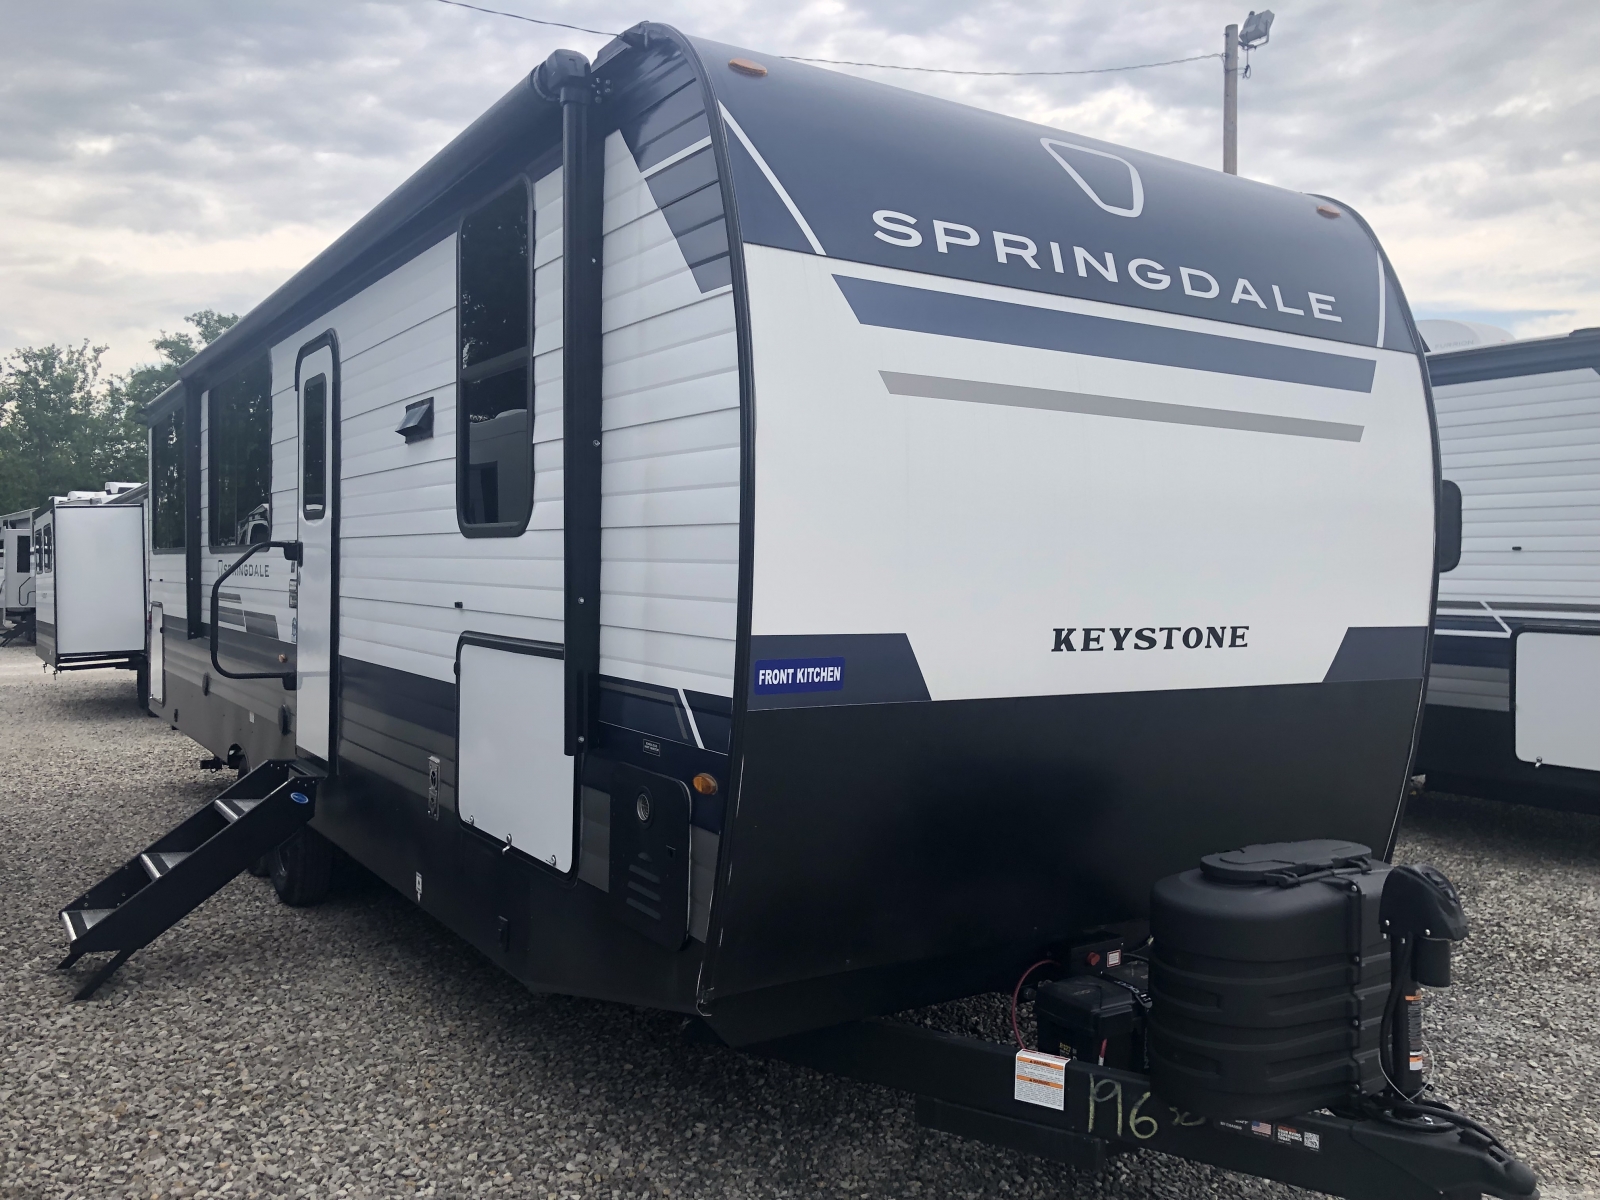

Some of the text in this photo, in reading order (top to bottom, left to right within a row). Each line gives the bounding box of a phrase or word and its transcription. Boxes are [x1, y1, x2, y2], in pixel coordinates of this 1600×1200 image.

[872, 209, 1343, 323] SPRINGDALE
[1051, 626, 1250, 652] KEYSTONE
[758, 666, 841, 686] FRONT KITCHEN
